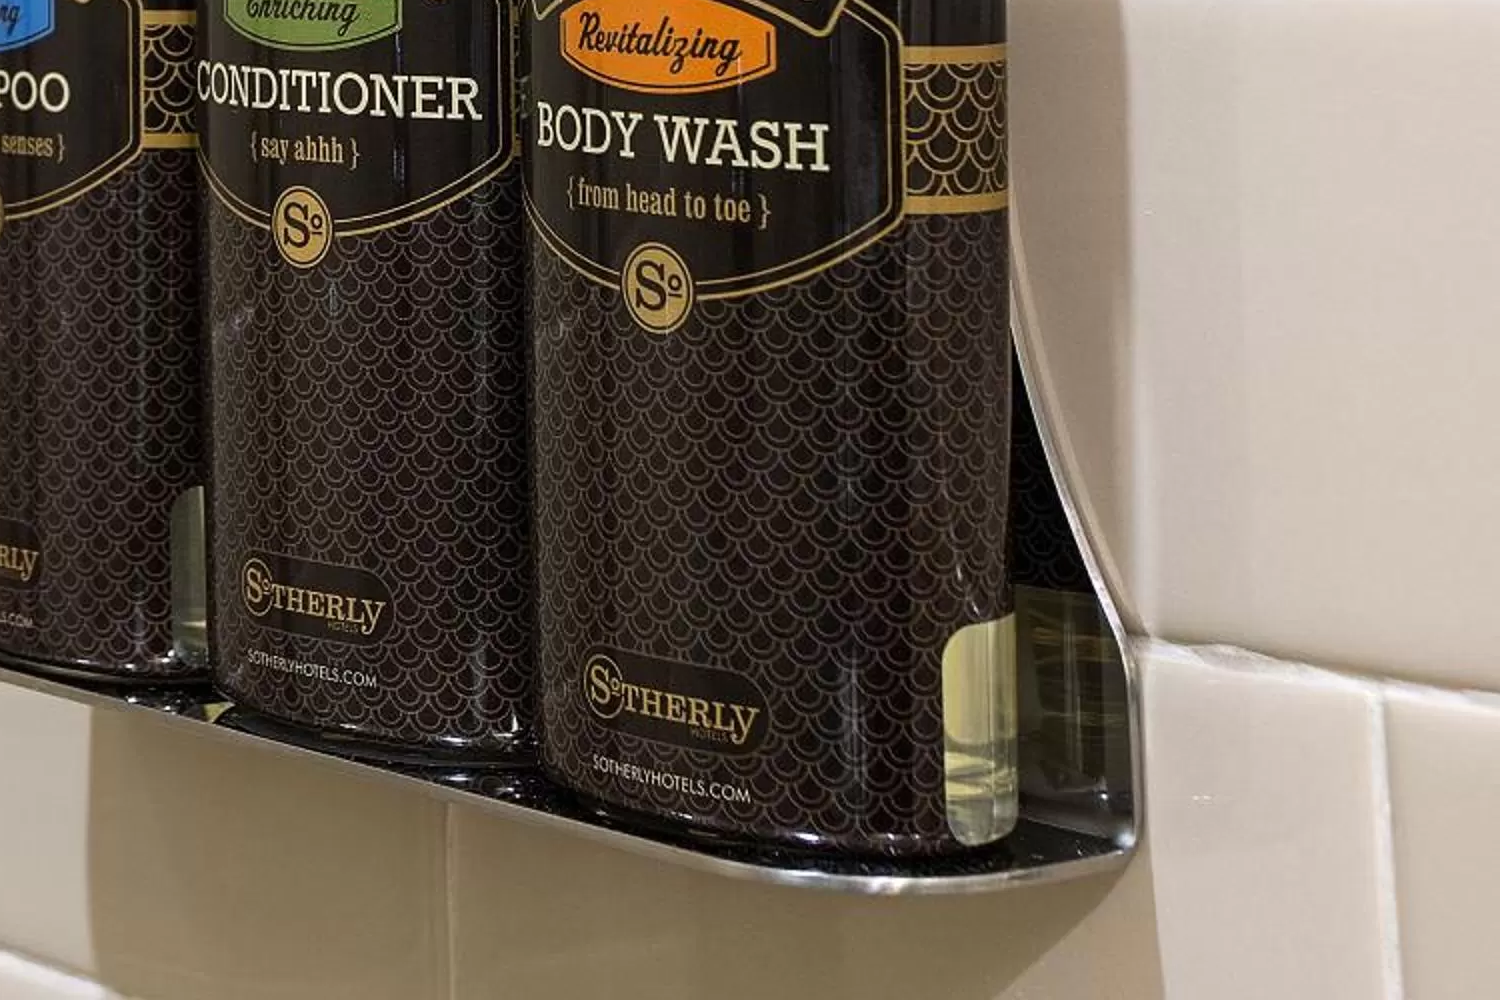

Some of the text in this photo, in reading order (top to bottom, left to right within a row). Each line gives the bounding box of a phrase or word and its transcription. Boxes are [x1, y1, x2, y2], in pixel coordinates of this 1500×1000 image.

[578, 11, 743, 76] Revitalizing
[197, 59, 483, 121] CONDITIONER
[1, 133, 54, 158] senses
[537, 101, 831, 173] BODY WASH
[625, 183, 677, 217] head
[683, 191, 706, 220] to
[247, 648, 378, 689] SOTHERLYHOTELS.COM
[593, 753, 751, 804] SOTHERLYHOTELS.COM
